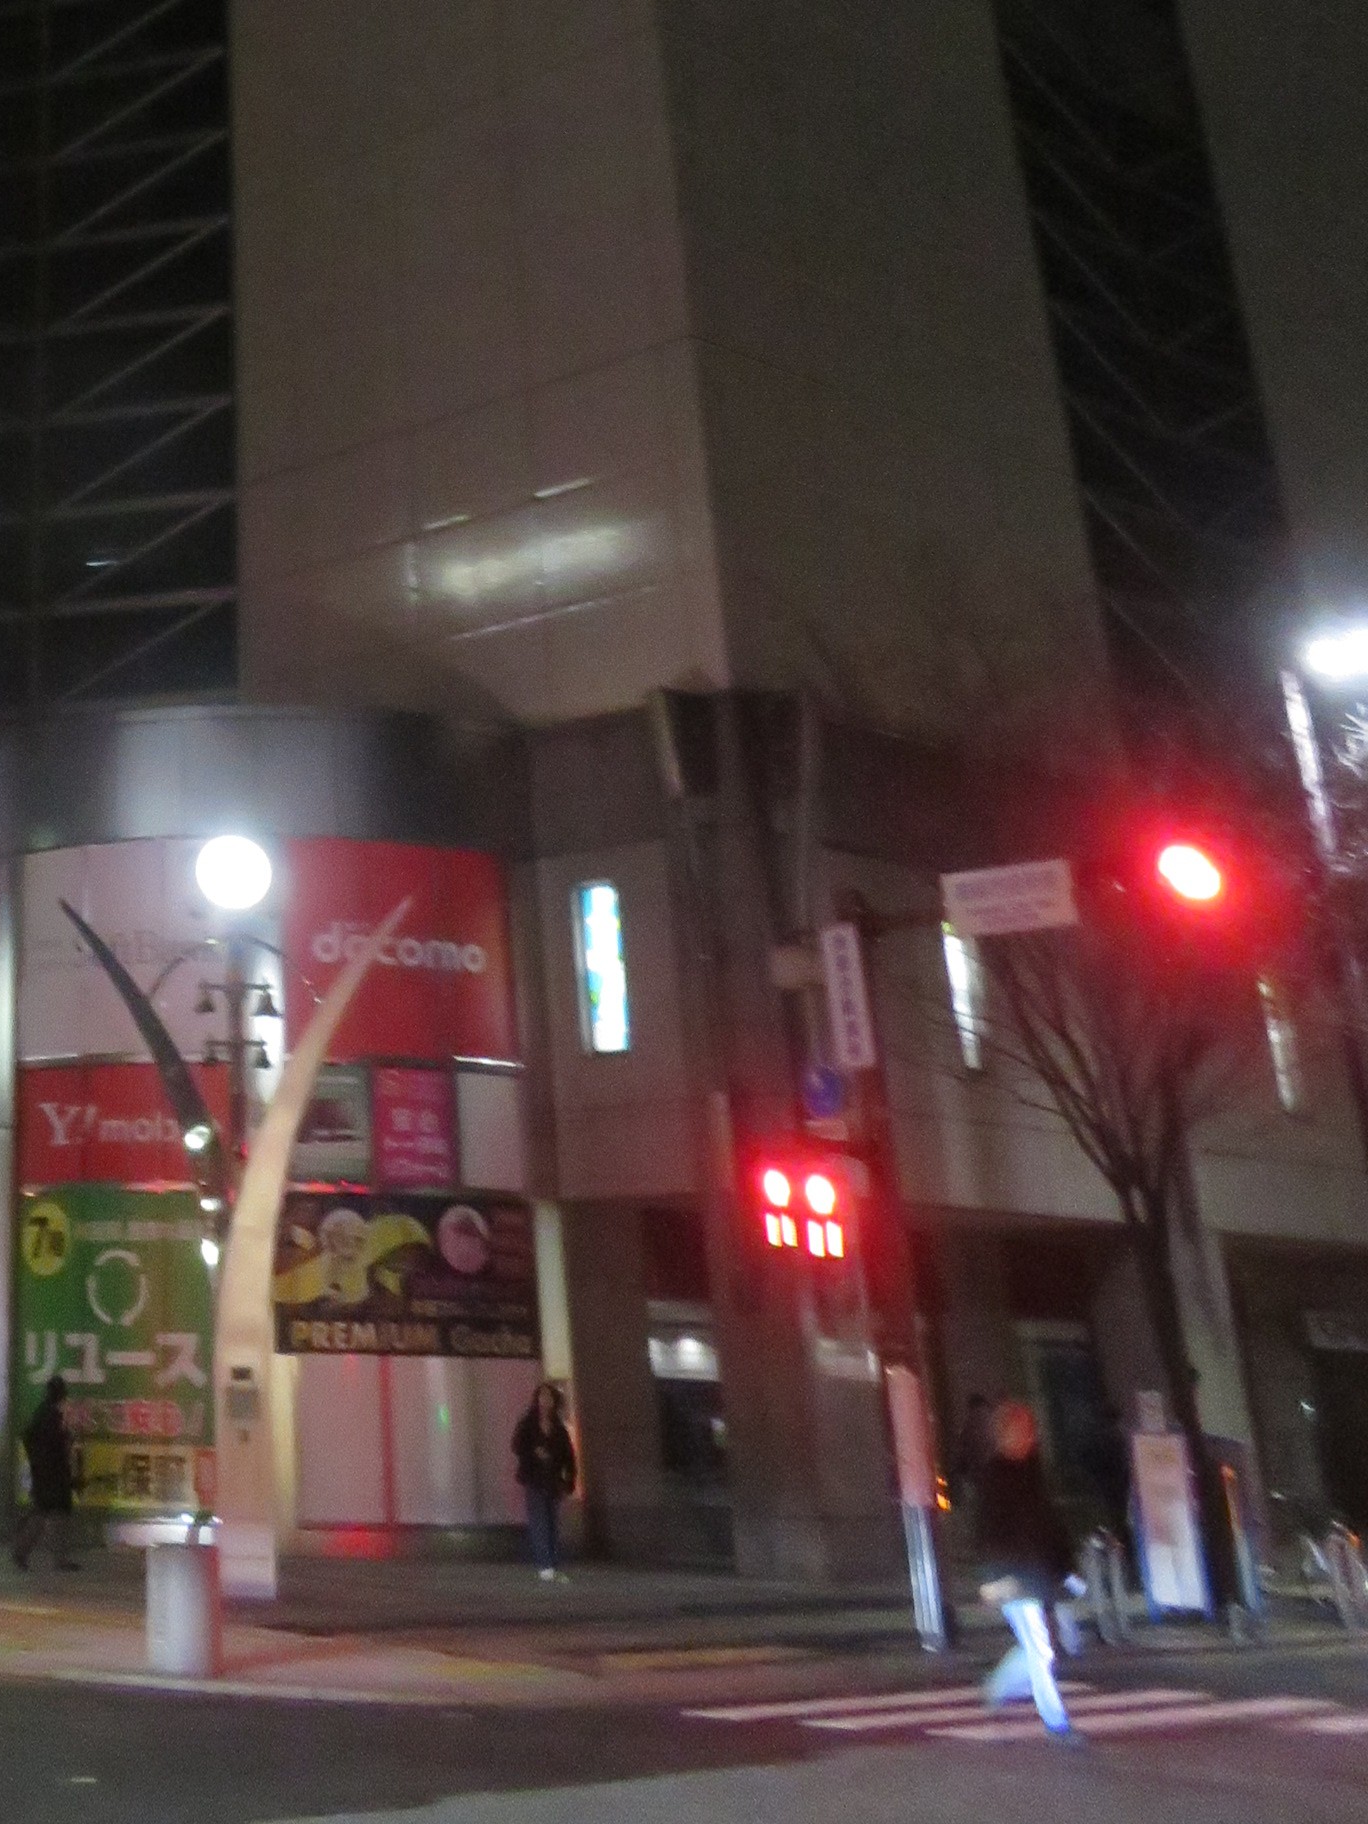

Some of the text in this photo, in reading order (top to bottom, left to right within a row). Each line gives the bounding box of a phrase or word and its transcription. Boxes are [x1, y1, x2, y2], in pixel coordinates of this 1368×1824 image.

[312, 921, 487, 974] docomo
[37, 1100, 220, 1148] Y!mob
[23, 1330, 209, 1389] リユース
[290, 1319, 439, 1351] PREMIUM
